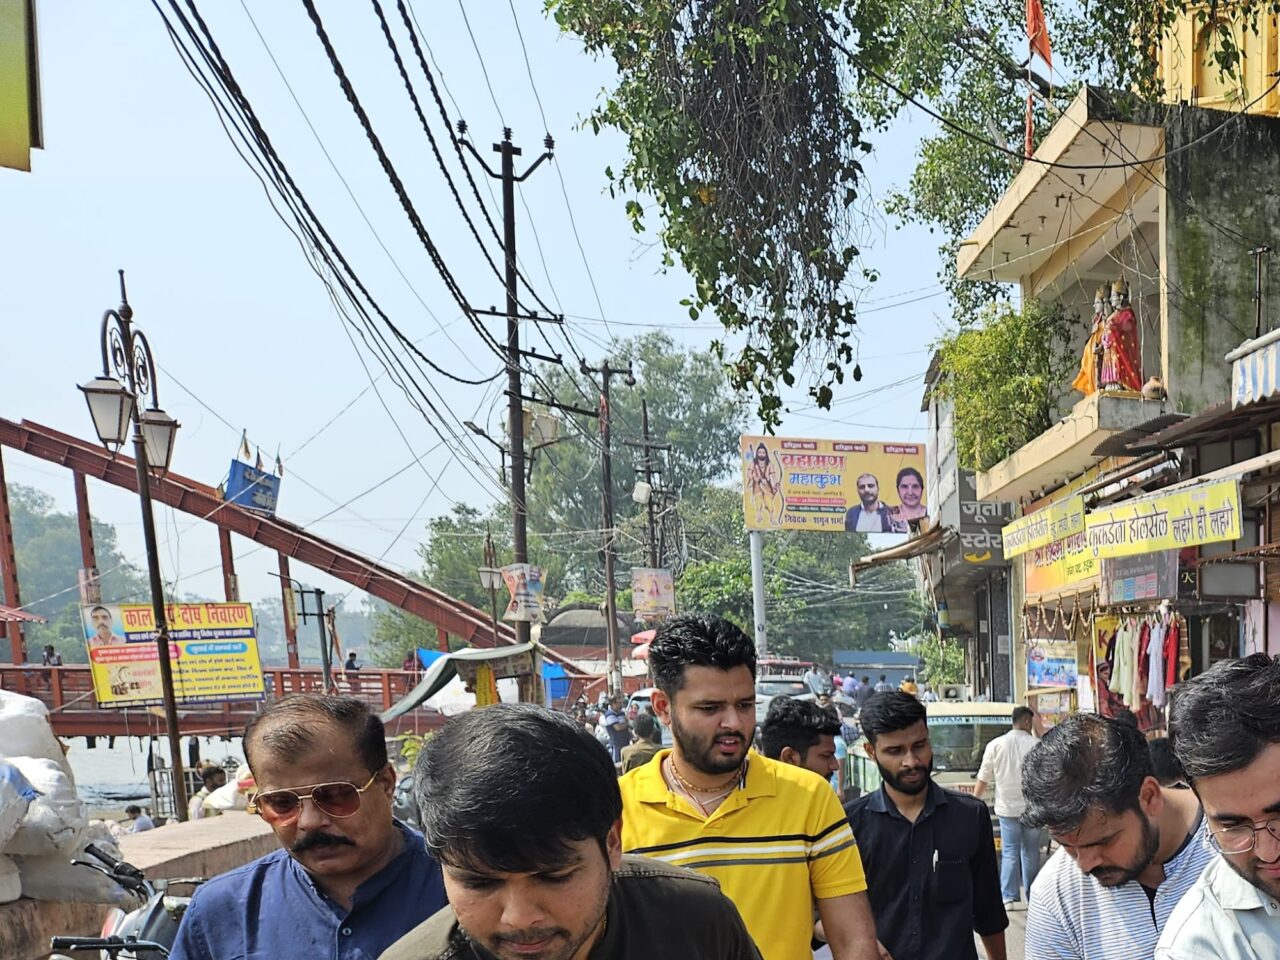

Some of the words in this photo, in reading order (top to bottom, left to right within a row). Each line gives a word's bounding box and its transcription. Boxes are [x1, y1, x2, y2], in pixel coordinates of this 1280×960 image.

[789, 471, 841, 488] महाकुंभ
[123, 608, 153, 627] काल
[206, 603, 249, 625] निवारण
